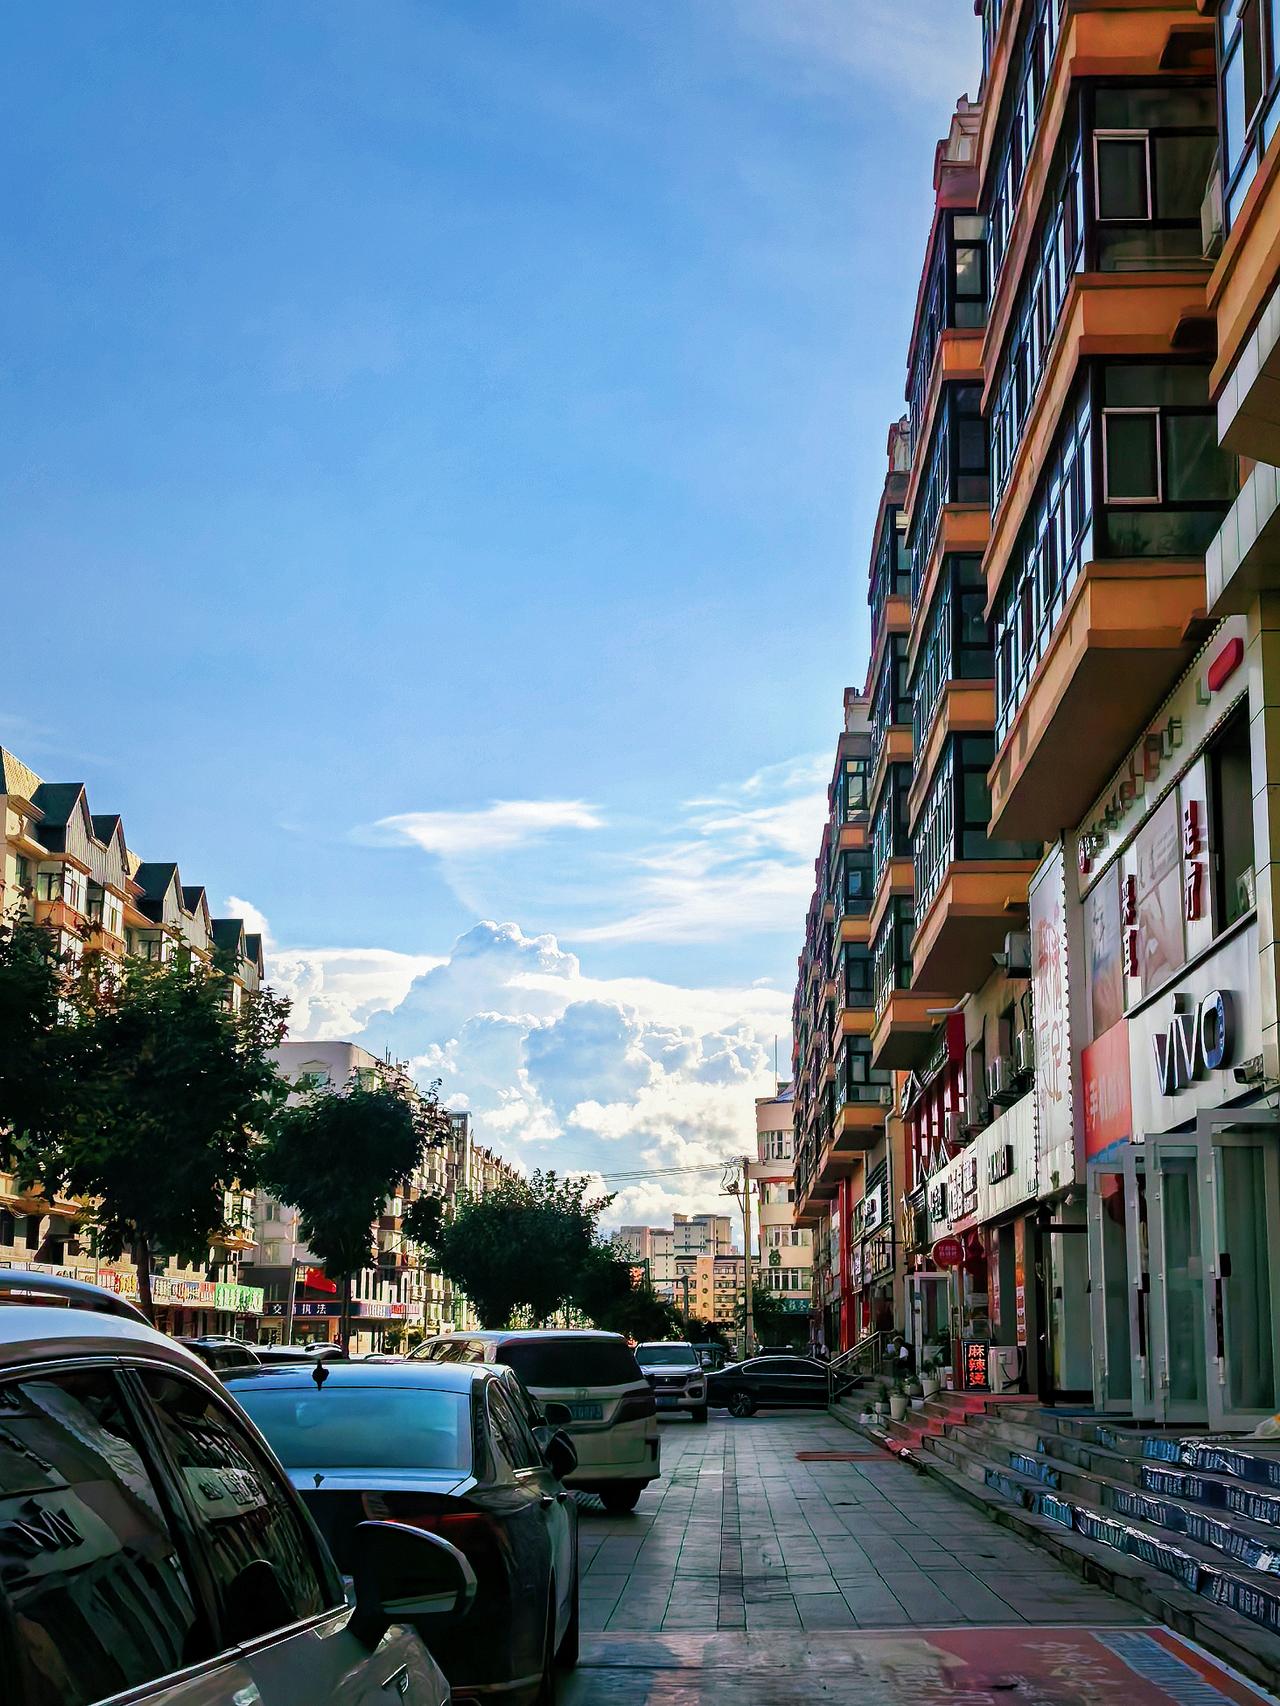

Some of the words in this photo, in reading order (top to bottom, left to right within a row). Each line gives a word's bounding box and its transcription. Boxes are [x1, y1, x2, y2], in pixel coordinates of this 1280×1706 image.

[1152, 990, 1230, 1096] vivo
[968, 1344, 986, 1386] 麻辣烫
